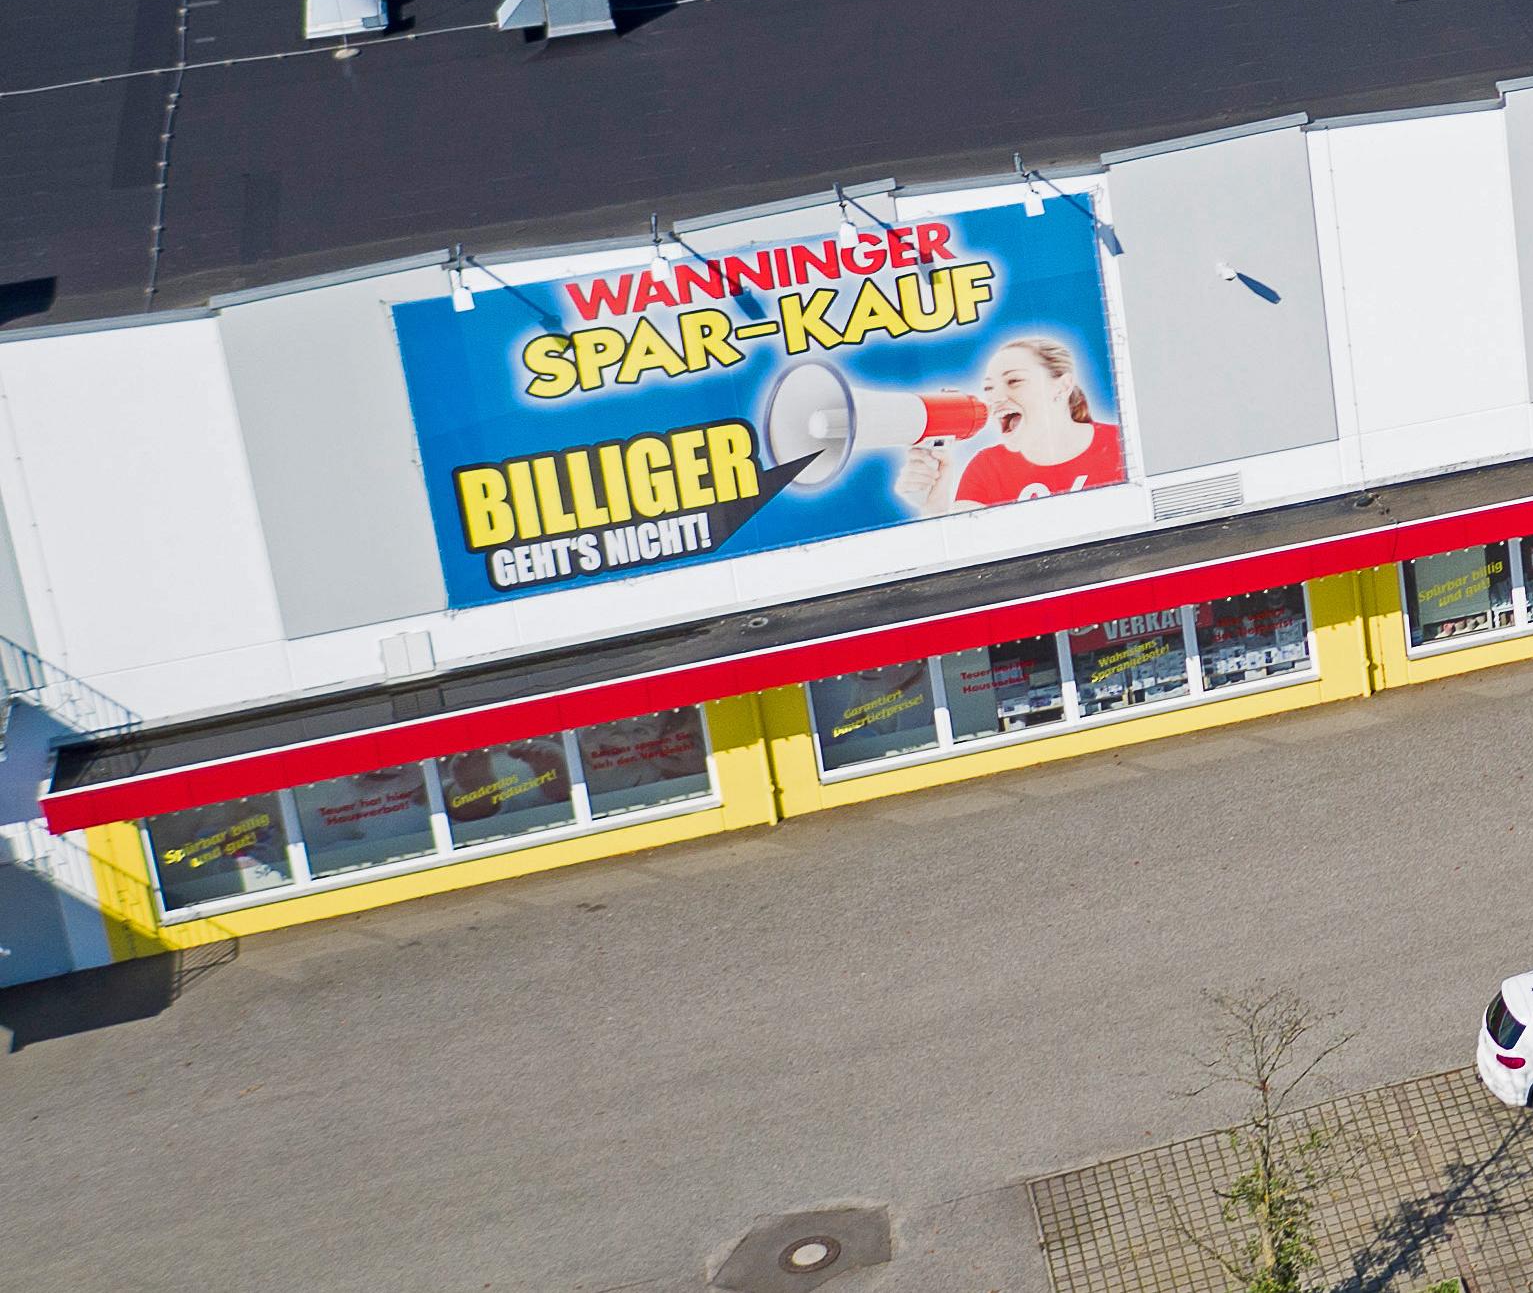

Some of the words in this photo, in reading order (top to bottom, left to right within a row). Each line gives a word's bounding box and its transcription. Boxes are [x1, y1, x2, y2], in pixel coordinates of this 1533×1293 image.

[565, 222, 956, 320] WANNINGER
[521, 262, 994, 398] SPAR-KAUF
[457, 422, 760, 551] BILLIGER
[608, 514, 713, 569] NICHT!
[1419, 573, 1467, 602] Spürbar
[1472, 560, 1503, 582] billig
[1438, 591, 1463, 607] und
[1090, 643, 1170, 683] Sparangebote!
[1097, 639, 1157, 668] Wahnsinns
[453, 773, 519, 807] Gnadenlos
[491, 769, 557, 805] reduziert!
